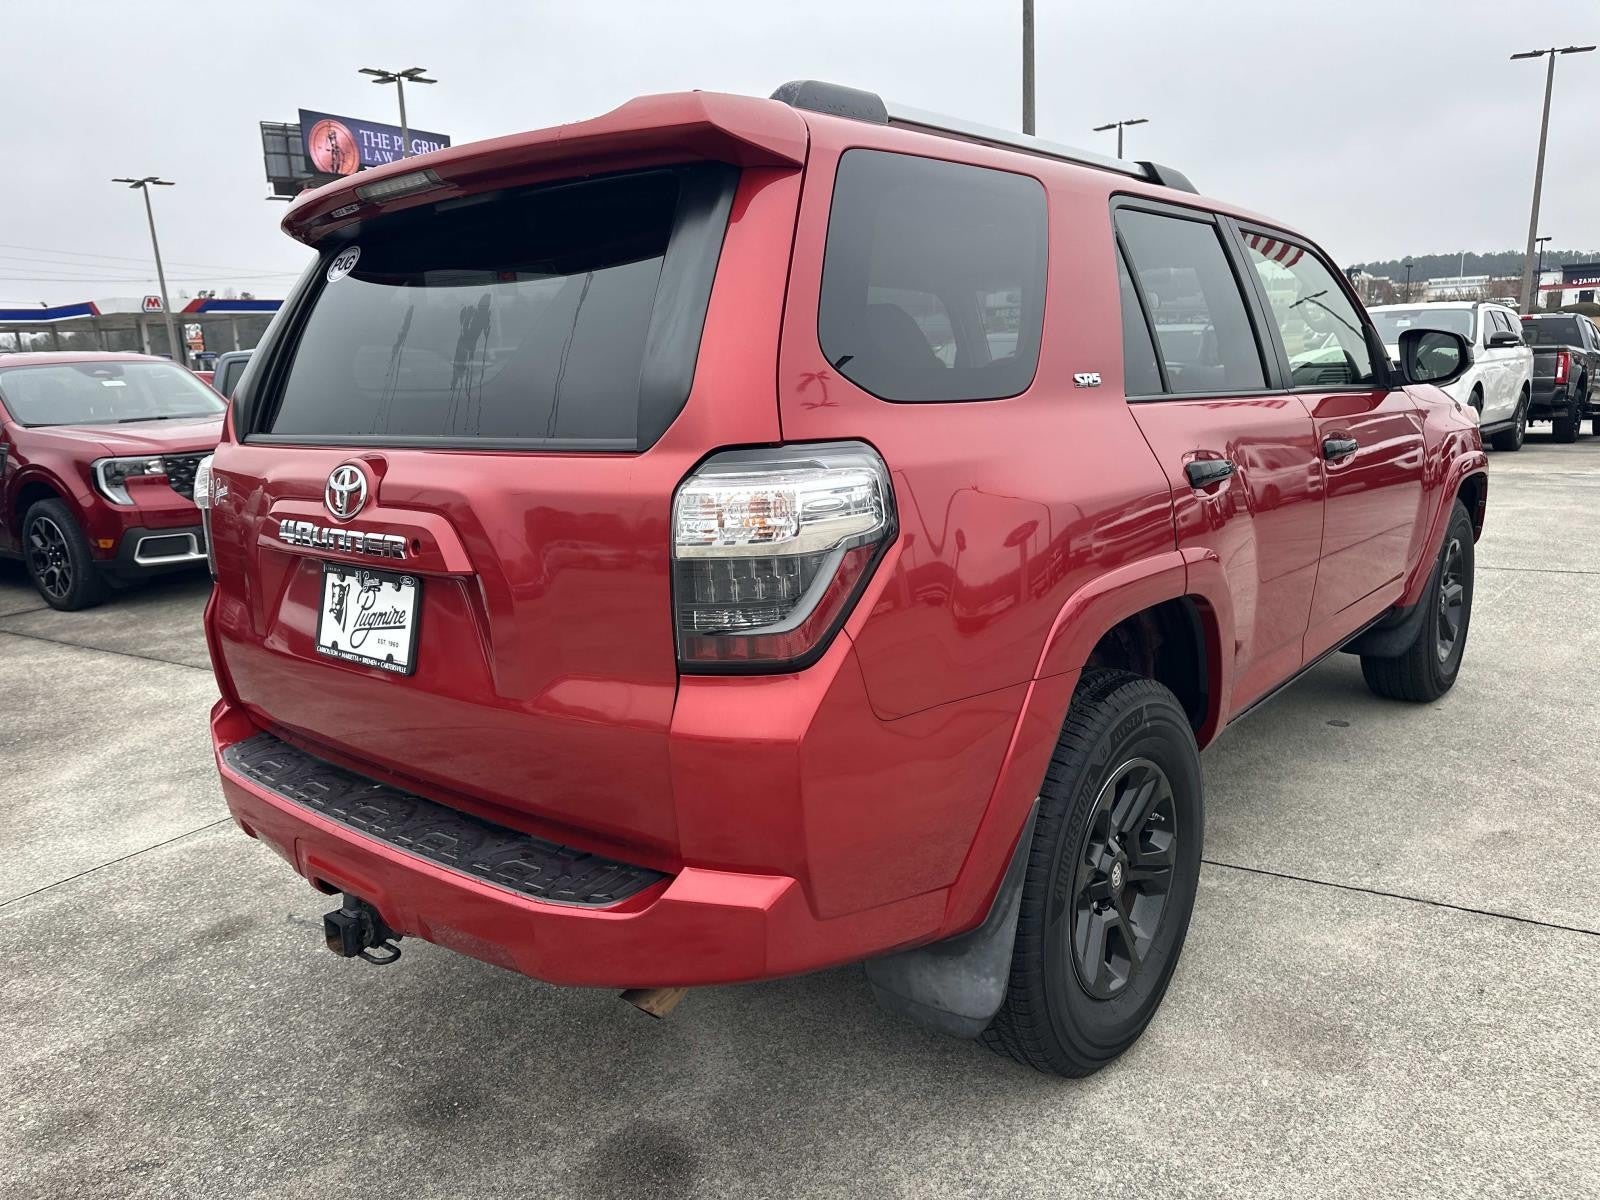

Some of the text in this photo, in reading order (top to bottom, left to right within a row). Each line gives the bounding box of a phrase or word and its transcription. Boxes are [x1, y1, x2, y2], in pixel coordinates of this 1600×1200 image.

[360, 130, 445, 155] THE PIGRIM
[364, 148, 394, 163] LAW
[331, 255, 356, 272] PUG
[1073, 372, 1101, 387] SR5
[279, 519, 407, 560] 4RUNNER
[350, 587, 407, 648] Pugmire
[1055, 774, 1097, 903] BRIDGESTONE
